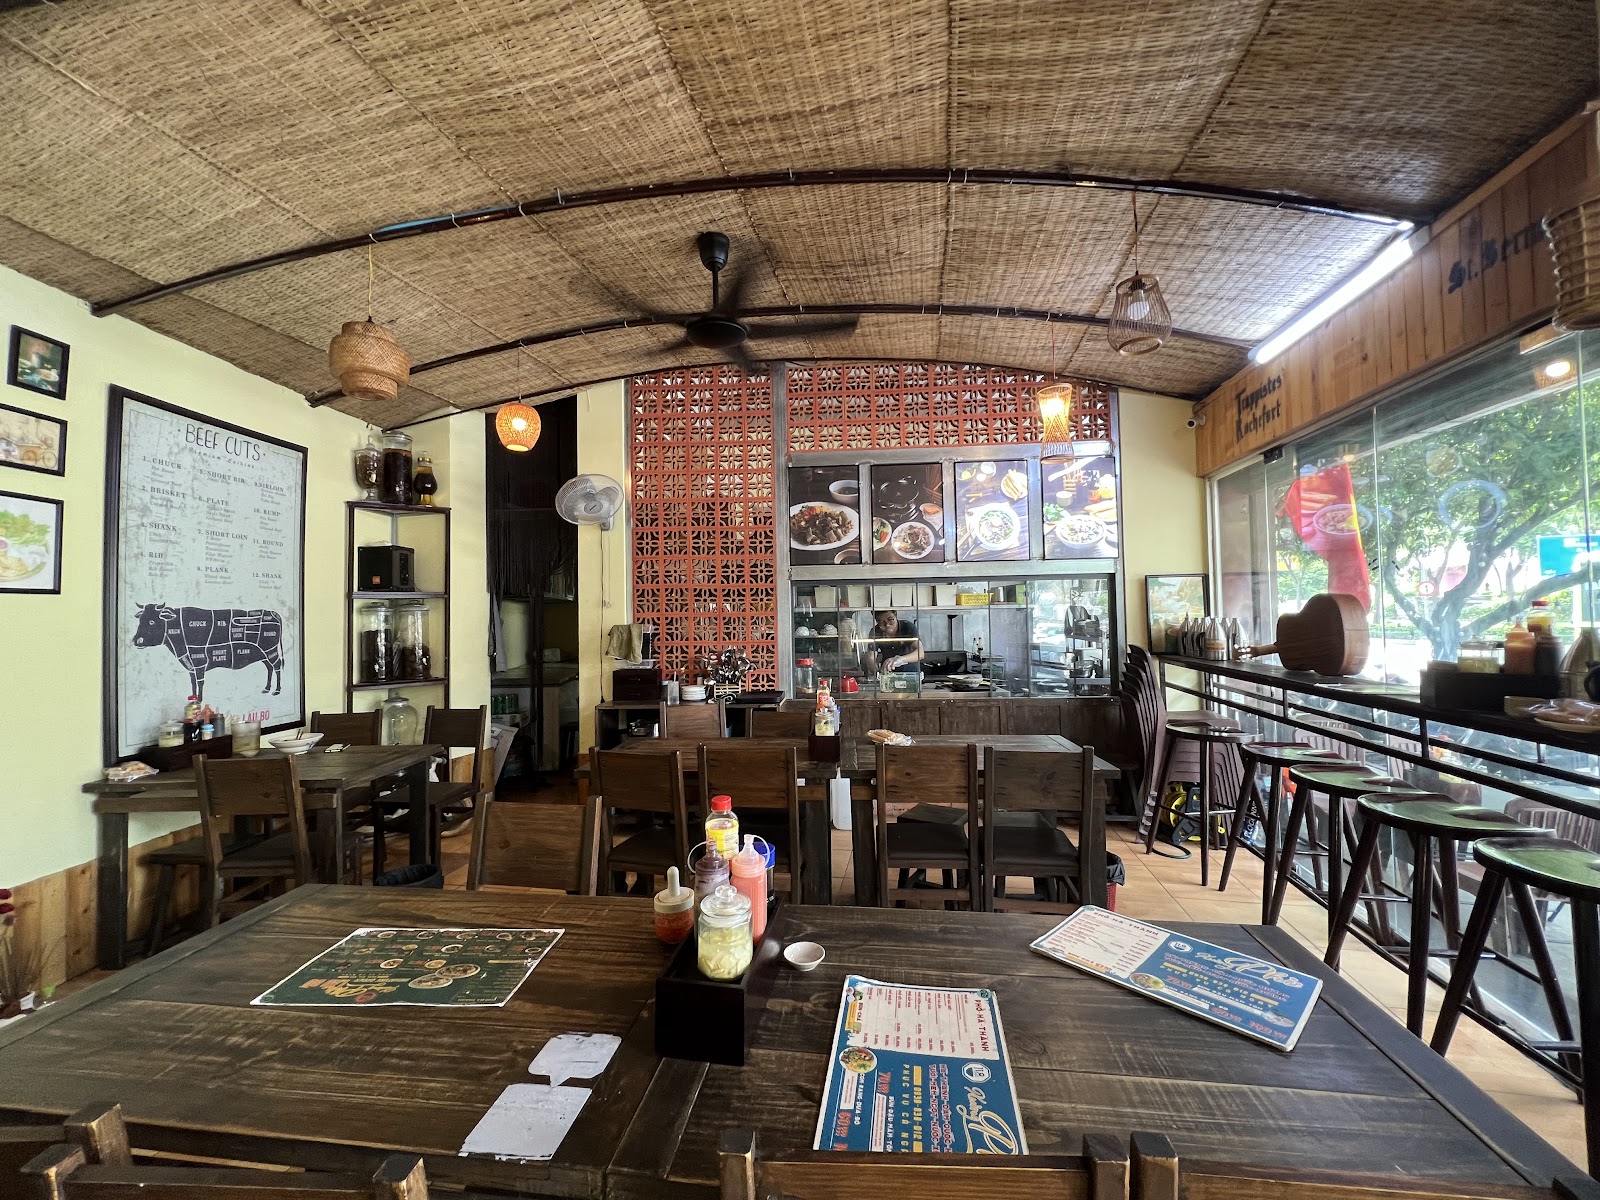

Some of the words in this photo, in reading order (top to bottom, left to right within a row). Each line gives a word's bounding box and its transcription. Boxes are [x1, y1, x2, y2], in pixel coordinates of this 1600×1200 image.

[185, 423, 219, 449] BEEF
[225, 436, 261, 461] CUTS
[152, 457, 182, 469] CHUCK
[206, 470, 232, 481] SHORT
[150, 486, 187, 499] BRISKET
[206, 497, 230, 507] PLATE
[149, 522, 178, 532] SHANK
[205, 529, 230, 538] SHORT
